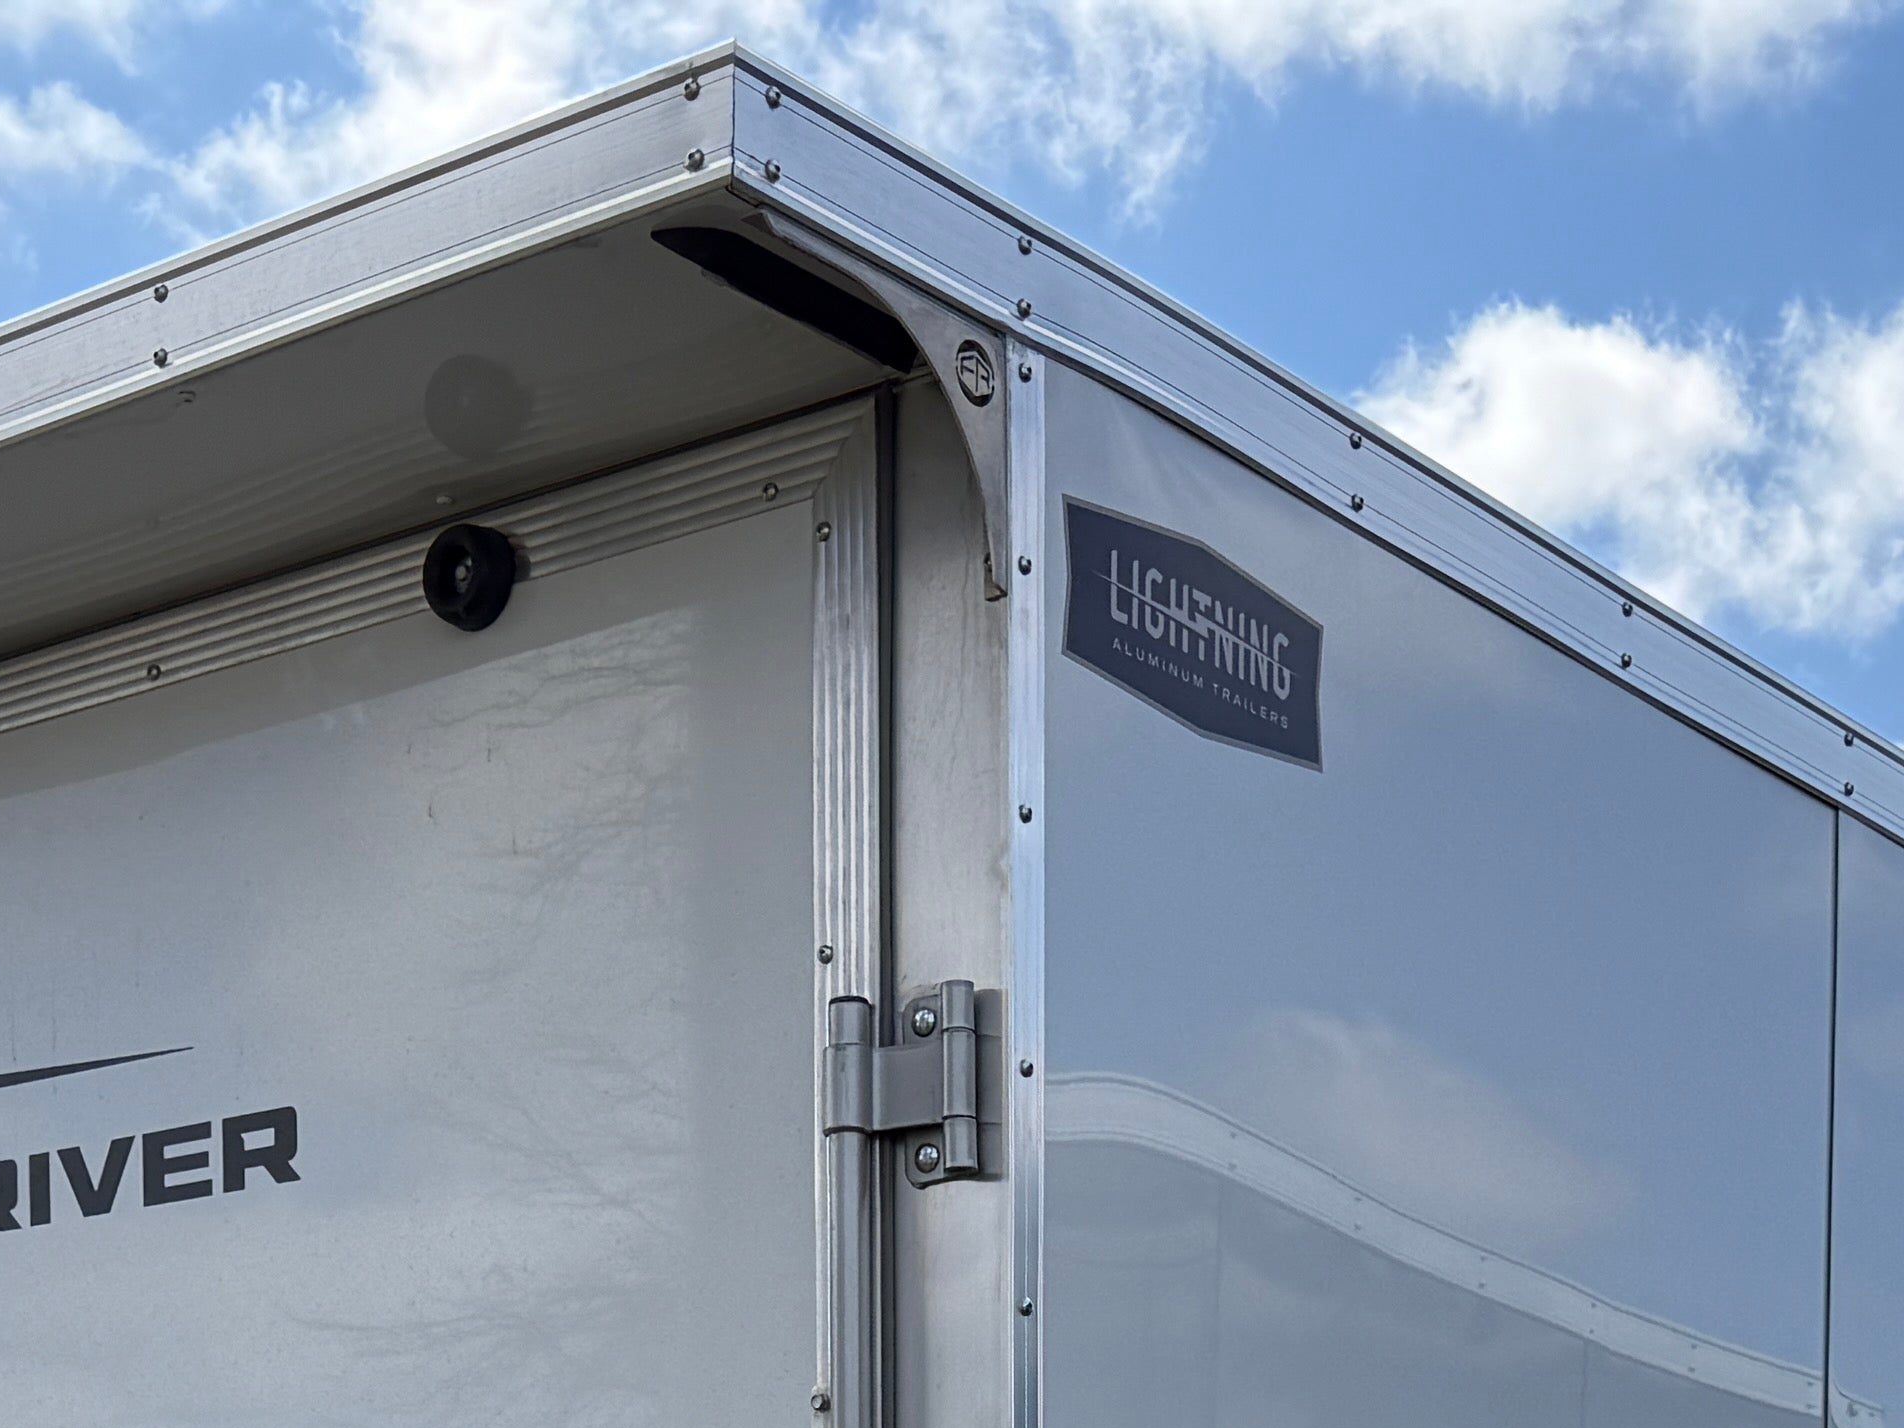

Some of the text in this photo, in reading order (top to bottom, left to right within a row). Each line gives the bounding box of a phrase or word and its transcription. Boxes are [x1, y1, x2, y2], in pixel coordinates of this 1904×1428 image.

[1109, 549, 1292, 702] LIGHTNING
[1112, 637, 1290, 729] ALUMINUM TRAILERS
